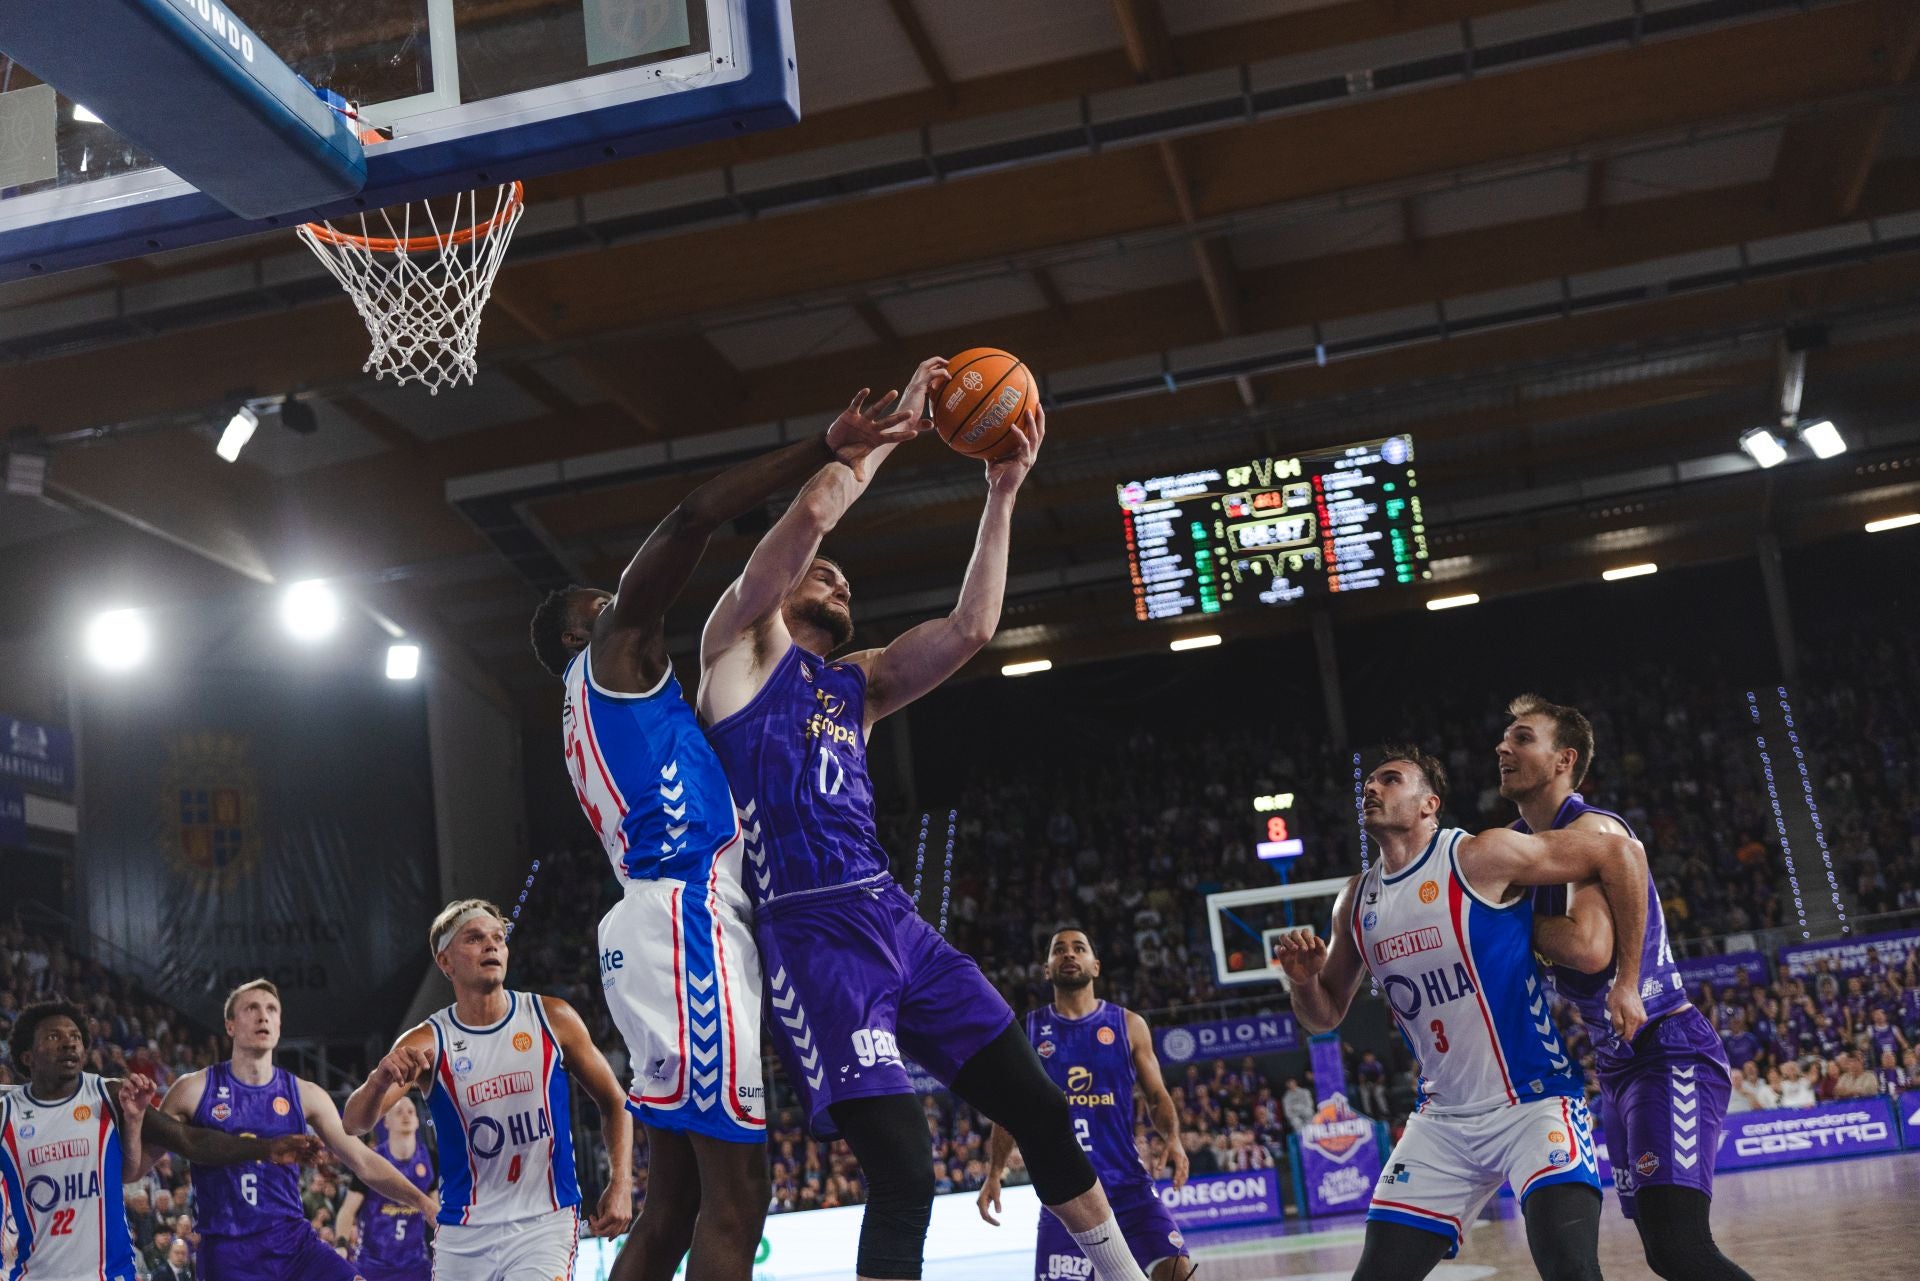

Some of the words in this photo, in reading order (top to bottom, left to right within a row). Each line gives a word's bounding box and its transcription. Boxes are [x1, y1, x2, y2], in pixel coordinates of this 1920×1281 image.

[184, 0, 254, 63] ONDO
[819, 746, 844, 795] 17
[1267, 816, 1289, 842] 8
[1375, 927, 1442, 964] LUCENTUM
[1421, 961, 1476, 1007] HLA
[1199, 1018, 1293, 1047] DIONI
[1430, 1019, 1450, 1054] 3
[468, 1072, 533, 1106] LUCENTUM
[508, 1107, 551, 1146] HLA
[1073, 1118, 1094, 1152] 2
[28, 1138, 90, 1167] LUCENTUM
[507, 1153, 522, 1184] 4
[64, 1170, 100, 1202] HLA
[240, 1173, 258, 1206] 6
[1160, 1176, 1267, 1209] OREGON
[50, 1208, 76, 1236] 22
[394, 1219, 408, 1241] 5
